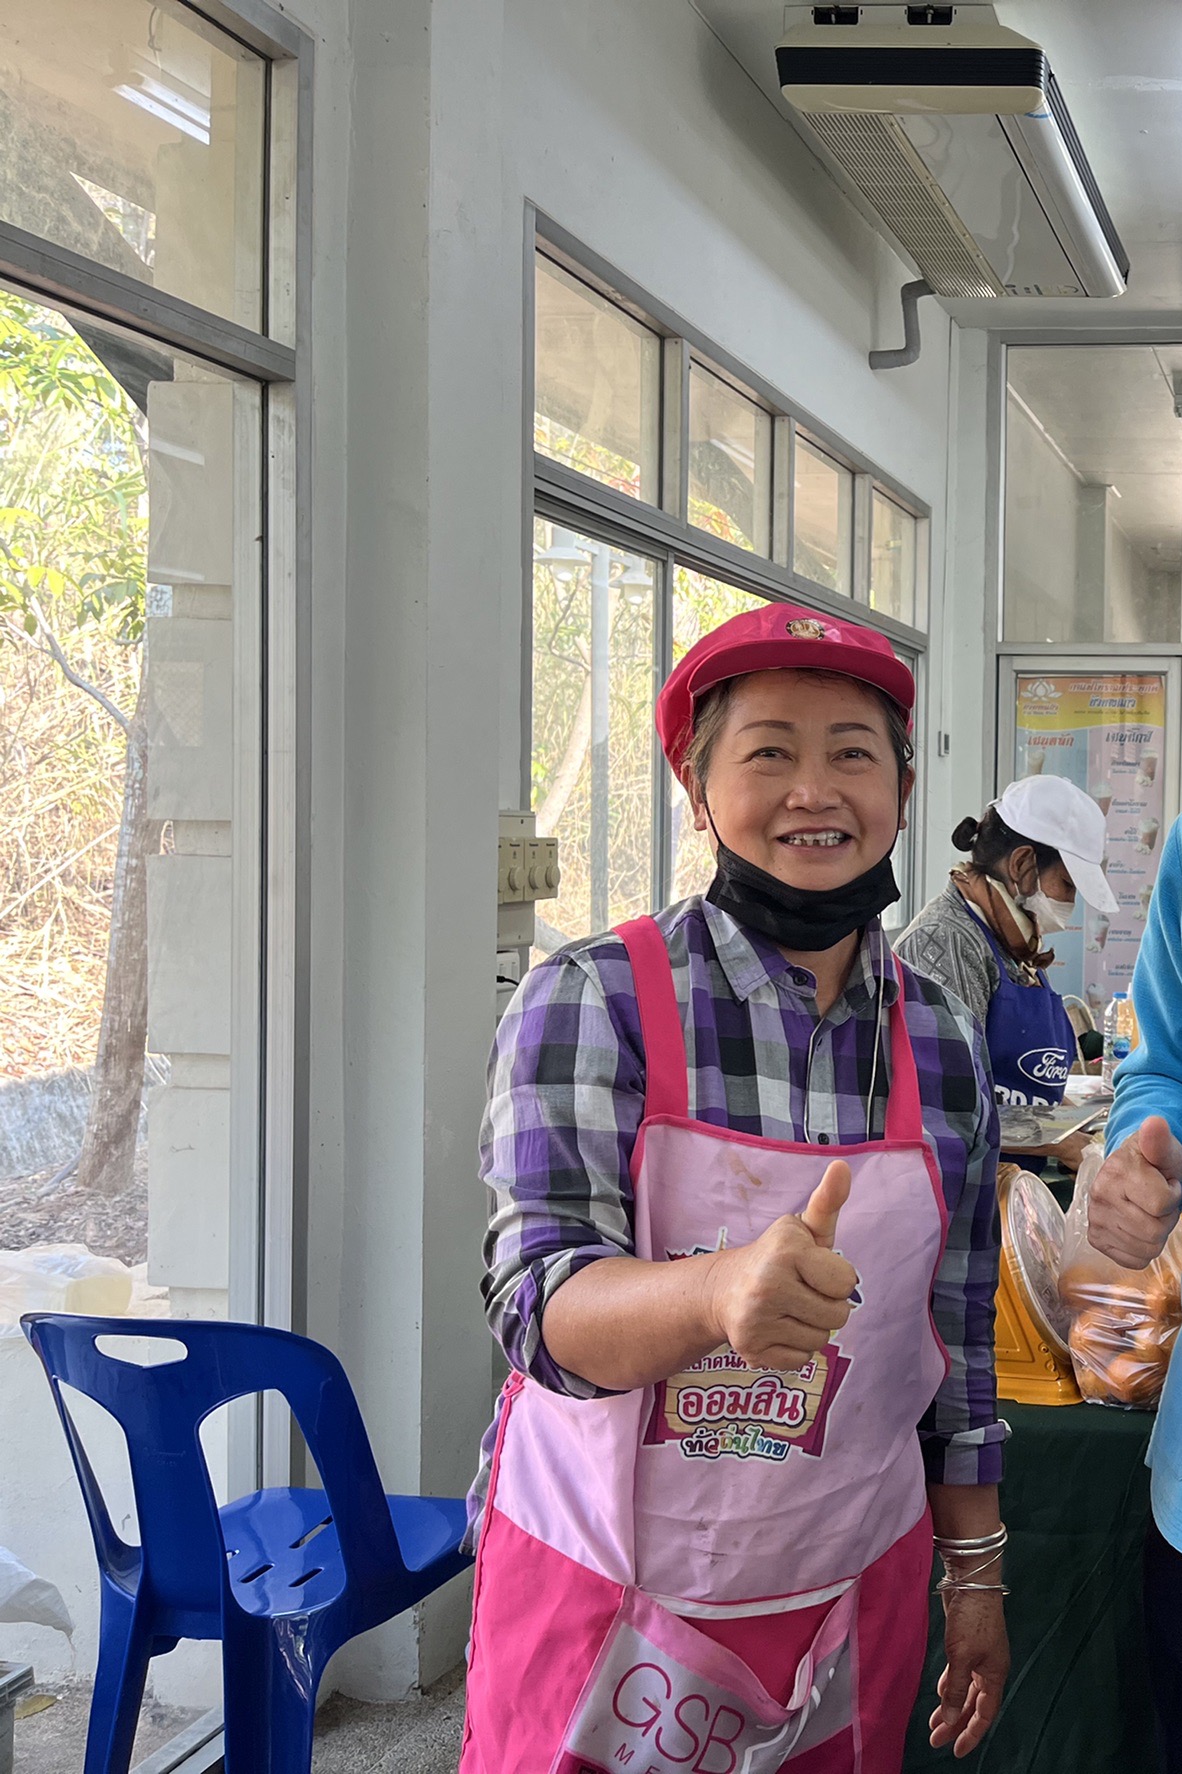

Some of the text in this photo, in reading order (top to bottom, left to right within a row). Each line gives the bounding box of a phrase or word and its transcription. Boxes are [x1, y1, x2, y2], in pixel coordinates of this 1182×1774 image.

[680, 1379, 802, 1422] ออมสิน
[683, 1424, 790, 1457] ทั่วถิ่นไทย
[612, 1662, 745, 1774] GSB
